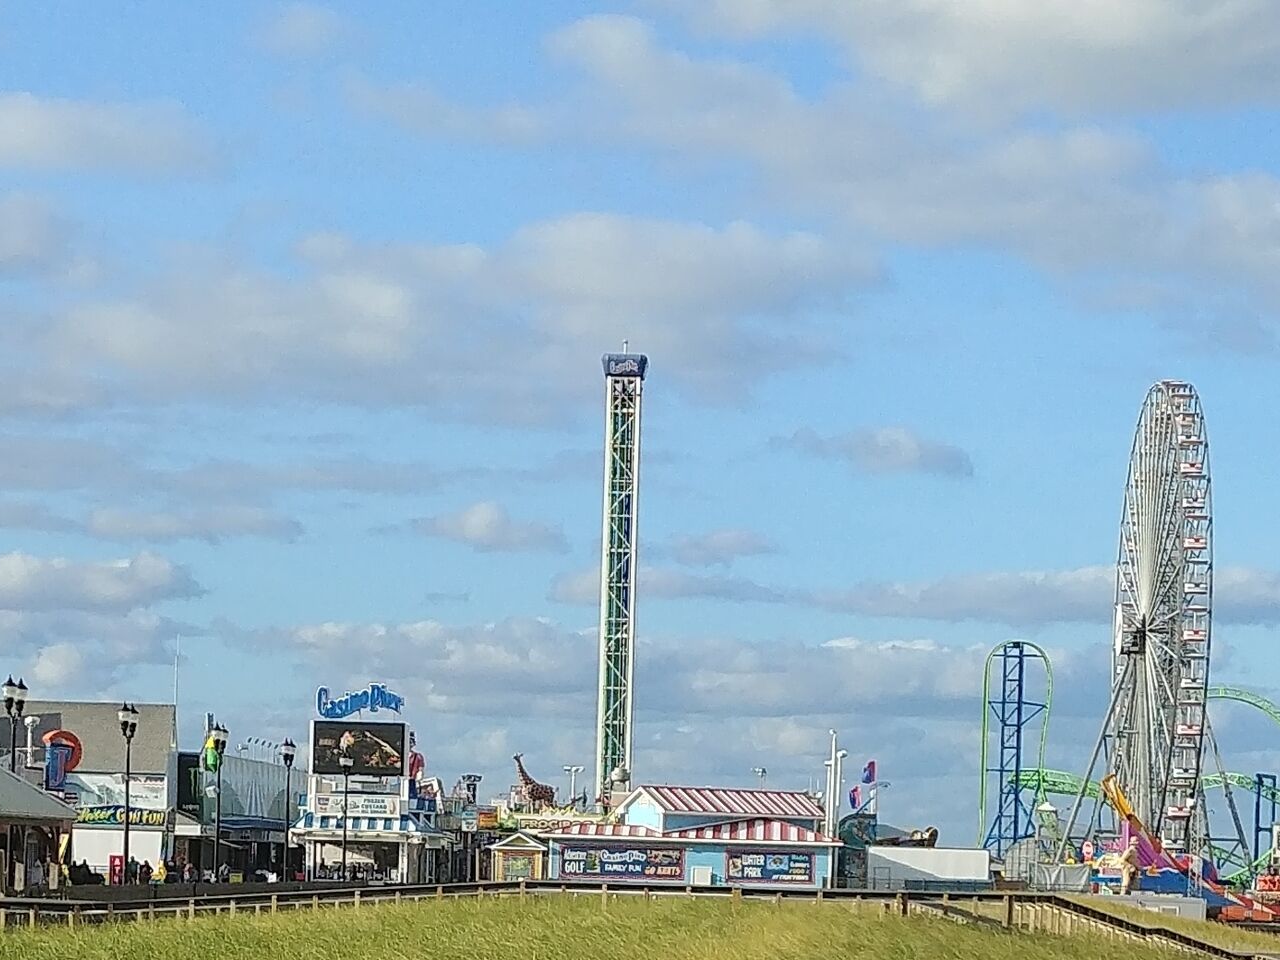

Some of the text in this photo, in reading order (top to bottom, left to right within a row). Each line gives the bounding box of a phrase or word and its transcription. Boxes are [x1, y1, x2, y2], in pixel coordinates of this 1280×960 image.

[141, 809, 165, 825] FUN
[741, 854, 765, 866] WATER
[564, 861, 586, 873] GOLF
[743, 866, 762, 878] PARK
